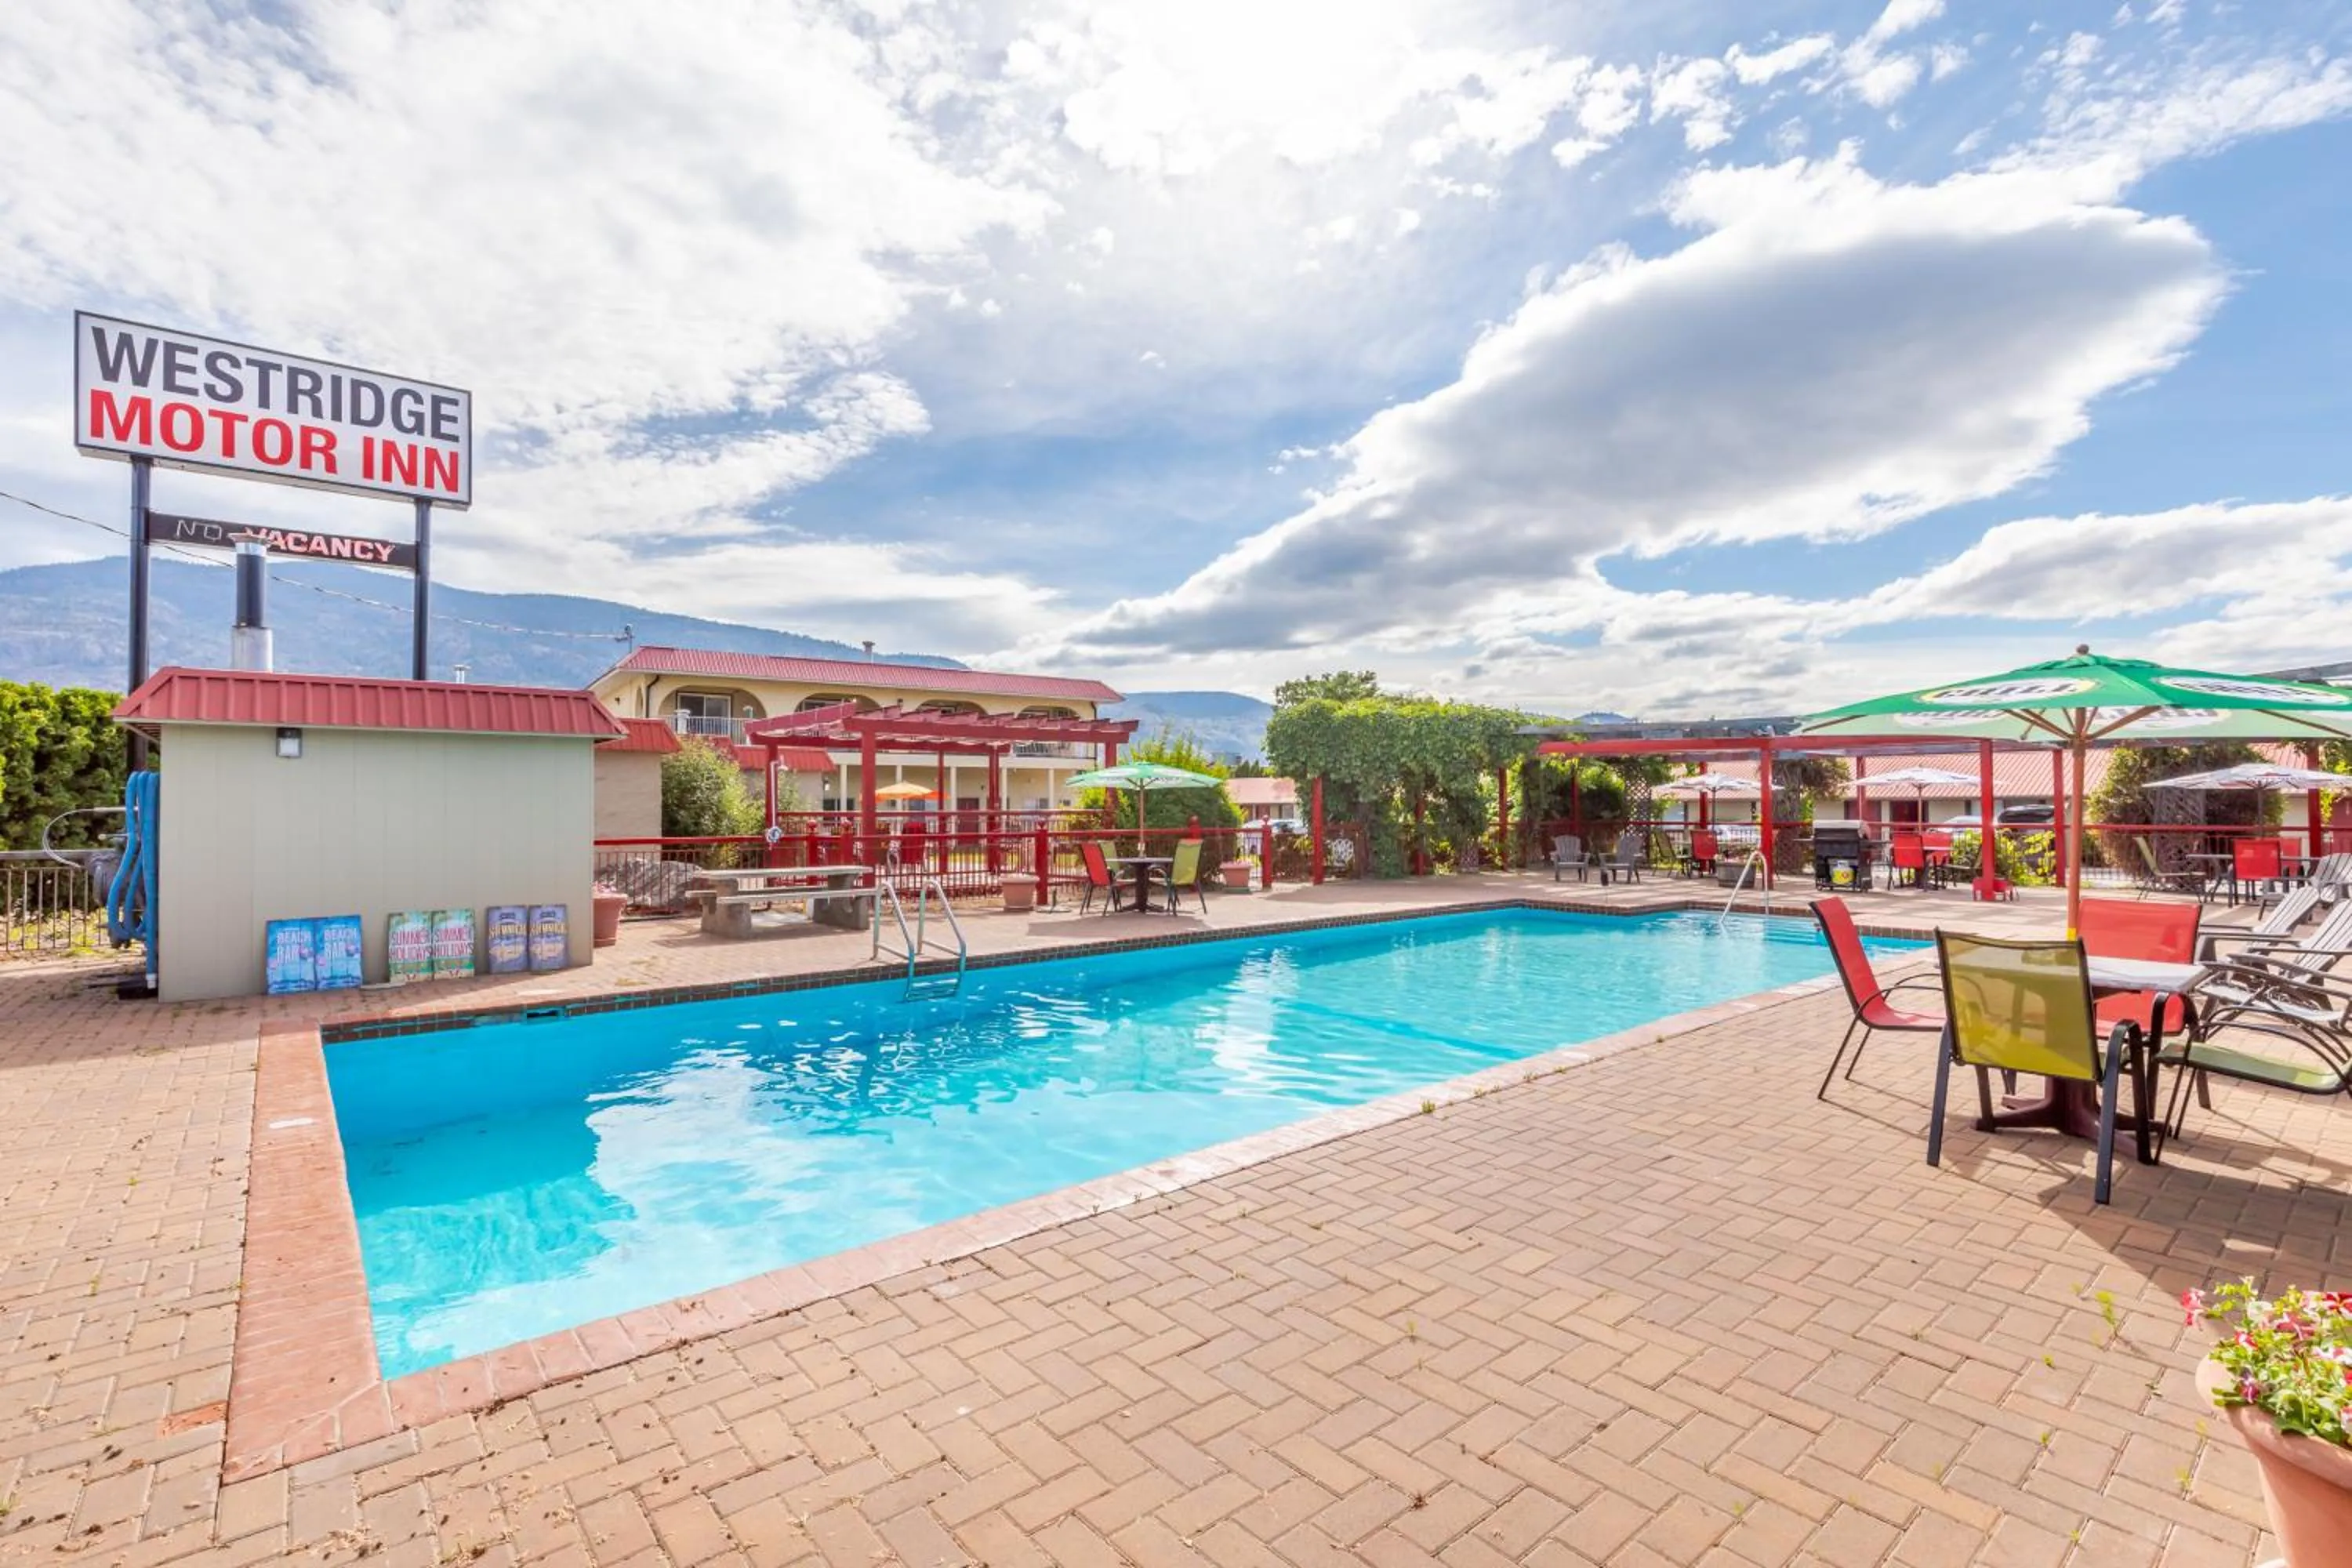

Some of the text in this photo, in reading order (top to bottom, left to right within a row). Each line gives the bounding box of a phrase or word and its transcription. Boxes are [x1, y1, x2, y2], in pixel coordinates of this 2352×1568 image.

[92, 326, 459, 442] WESTRIDGE
[90, 389, 459, 492] MOTOR INN
[176, 520, 223, 541] NO
